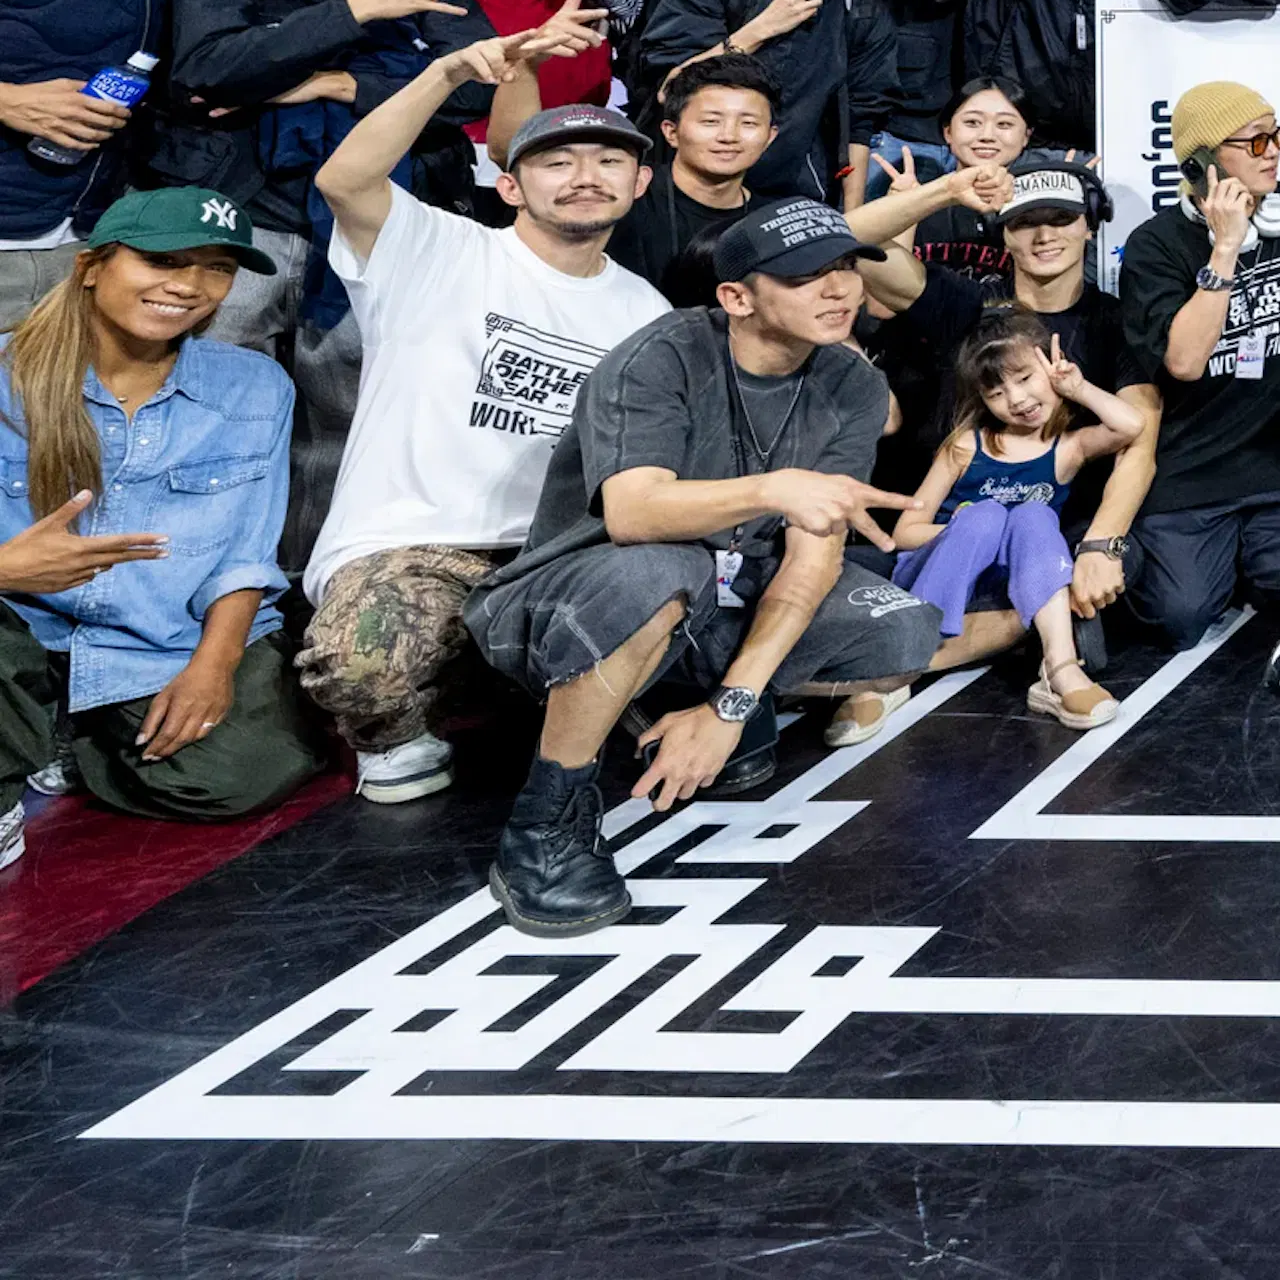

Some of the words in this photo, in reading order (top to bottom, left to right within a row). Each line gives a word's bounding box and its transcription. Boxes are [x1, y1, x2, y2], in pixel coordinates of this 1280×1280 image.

[200, 198, 237, 231] NY
[495, 364, 528, 382] OF
[530, 374, 577, 396] THE
[500, 349, 590, 385] BATTLE
[505, 380, 549, 404] EAR
[469, 401, 538, 435] WORL
